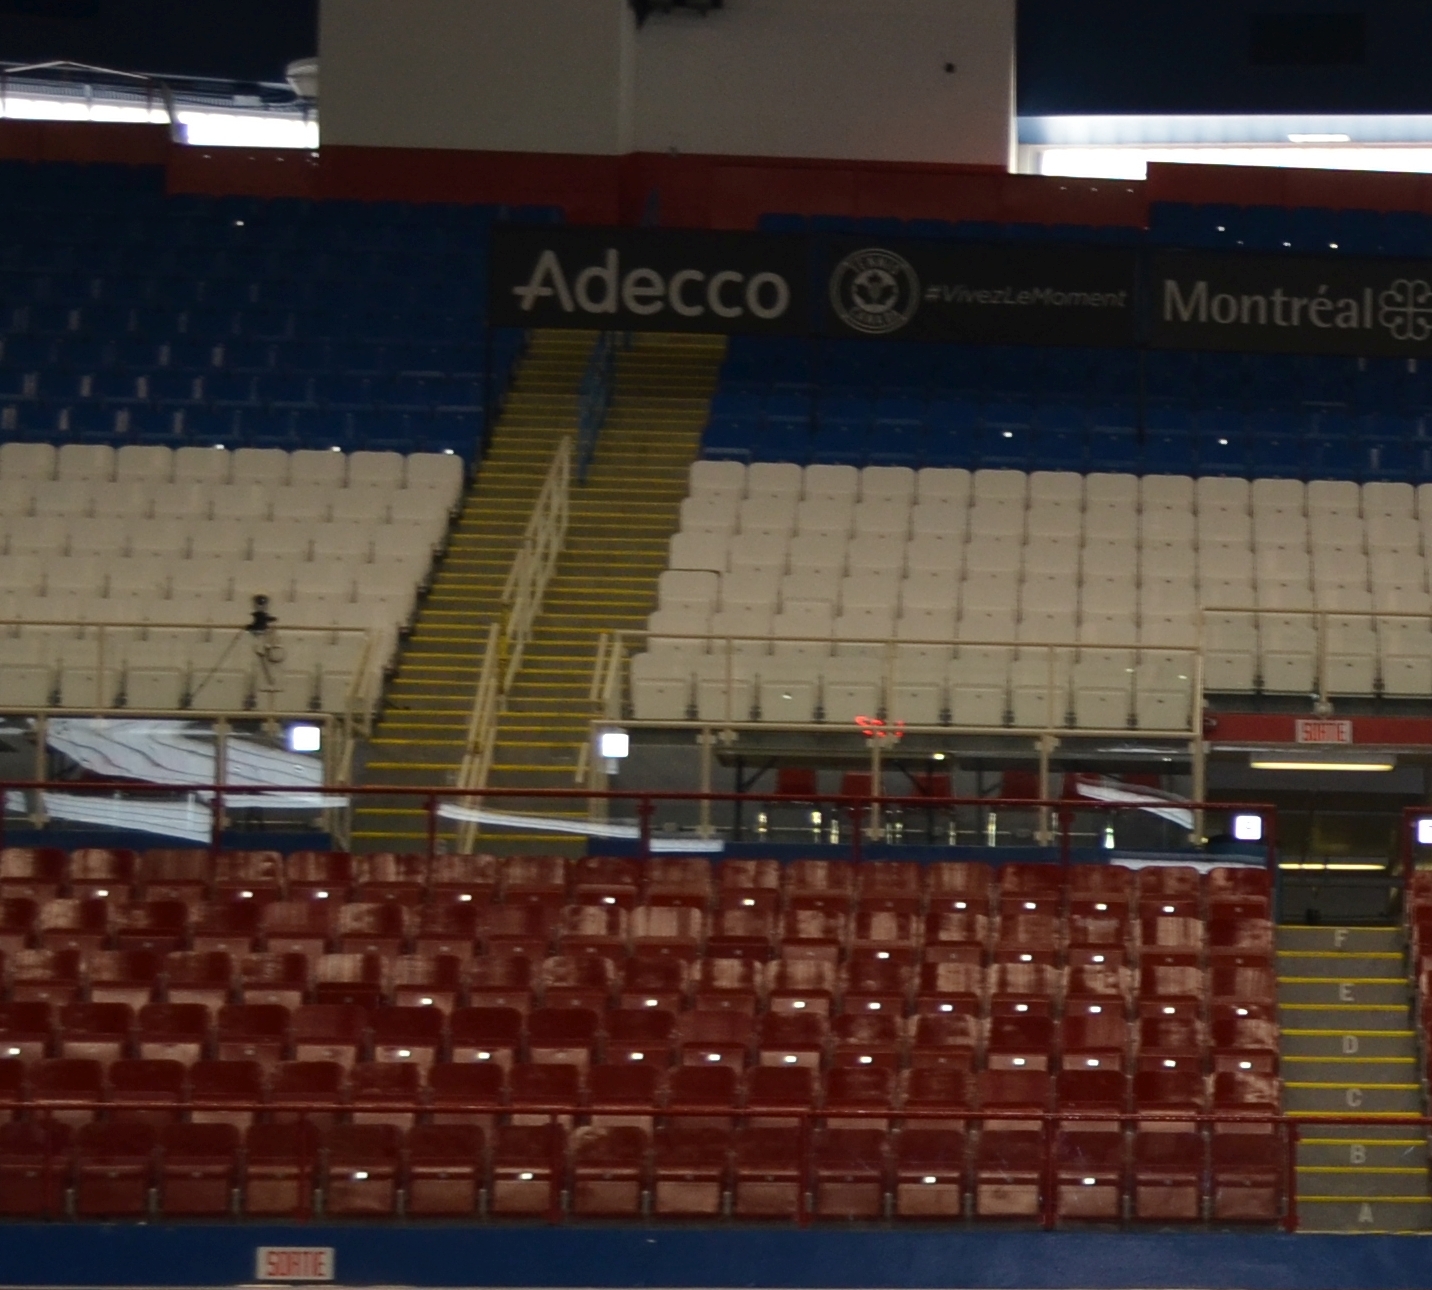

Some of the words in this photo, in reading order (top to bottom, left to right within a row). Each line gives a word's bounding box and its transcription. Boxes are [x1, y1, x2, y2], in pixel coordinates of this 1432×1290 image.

[514, 247, 791, 318] Adecco
[924, 283, 1128, 307] #VivezLeMoment
[1162, 278, 1374, 330] Montréal
[1334, 929, 1348, 947] F
[1339, 984, 1354, 1001] E
[1343, 1036, 1358, 1053] D
[1346, 1089, 1362, 1107] C
[1350, 1145, 1366, 1163] B
[1358, 1203, 1374, 1223] A
